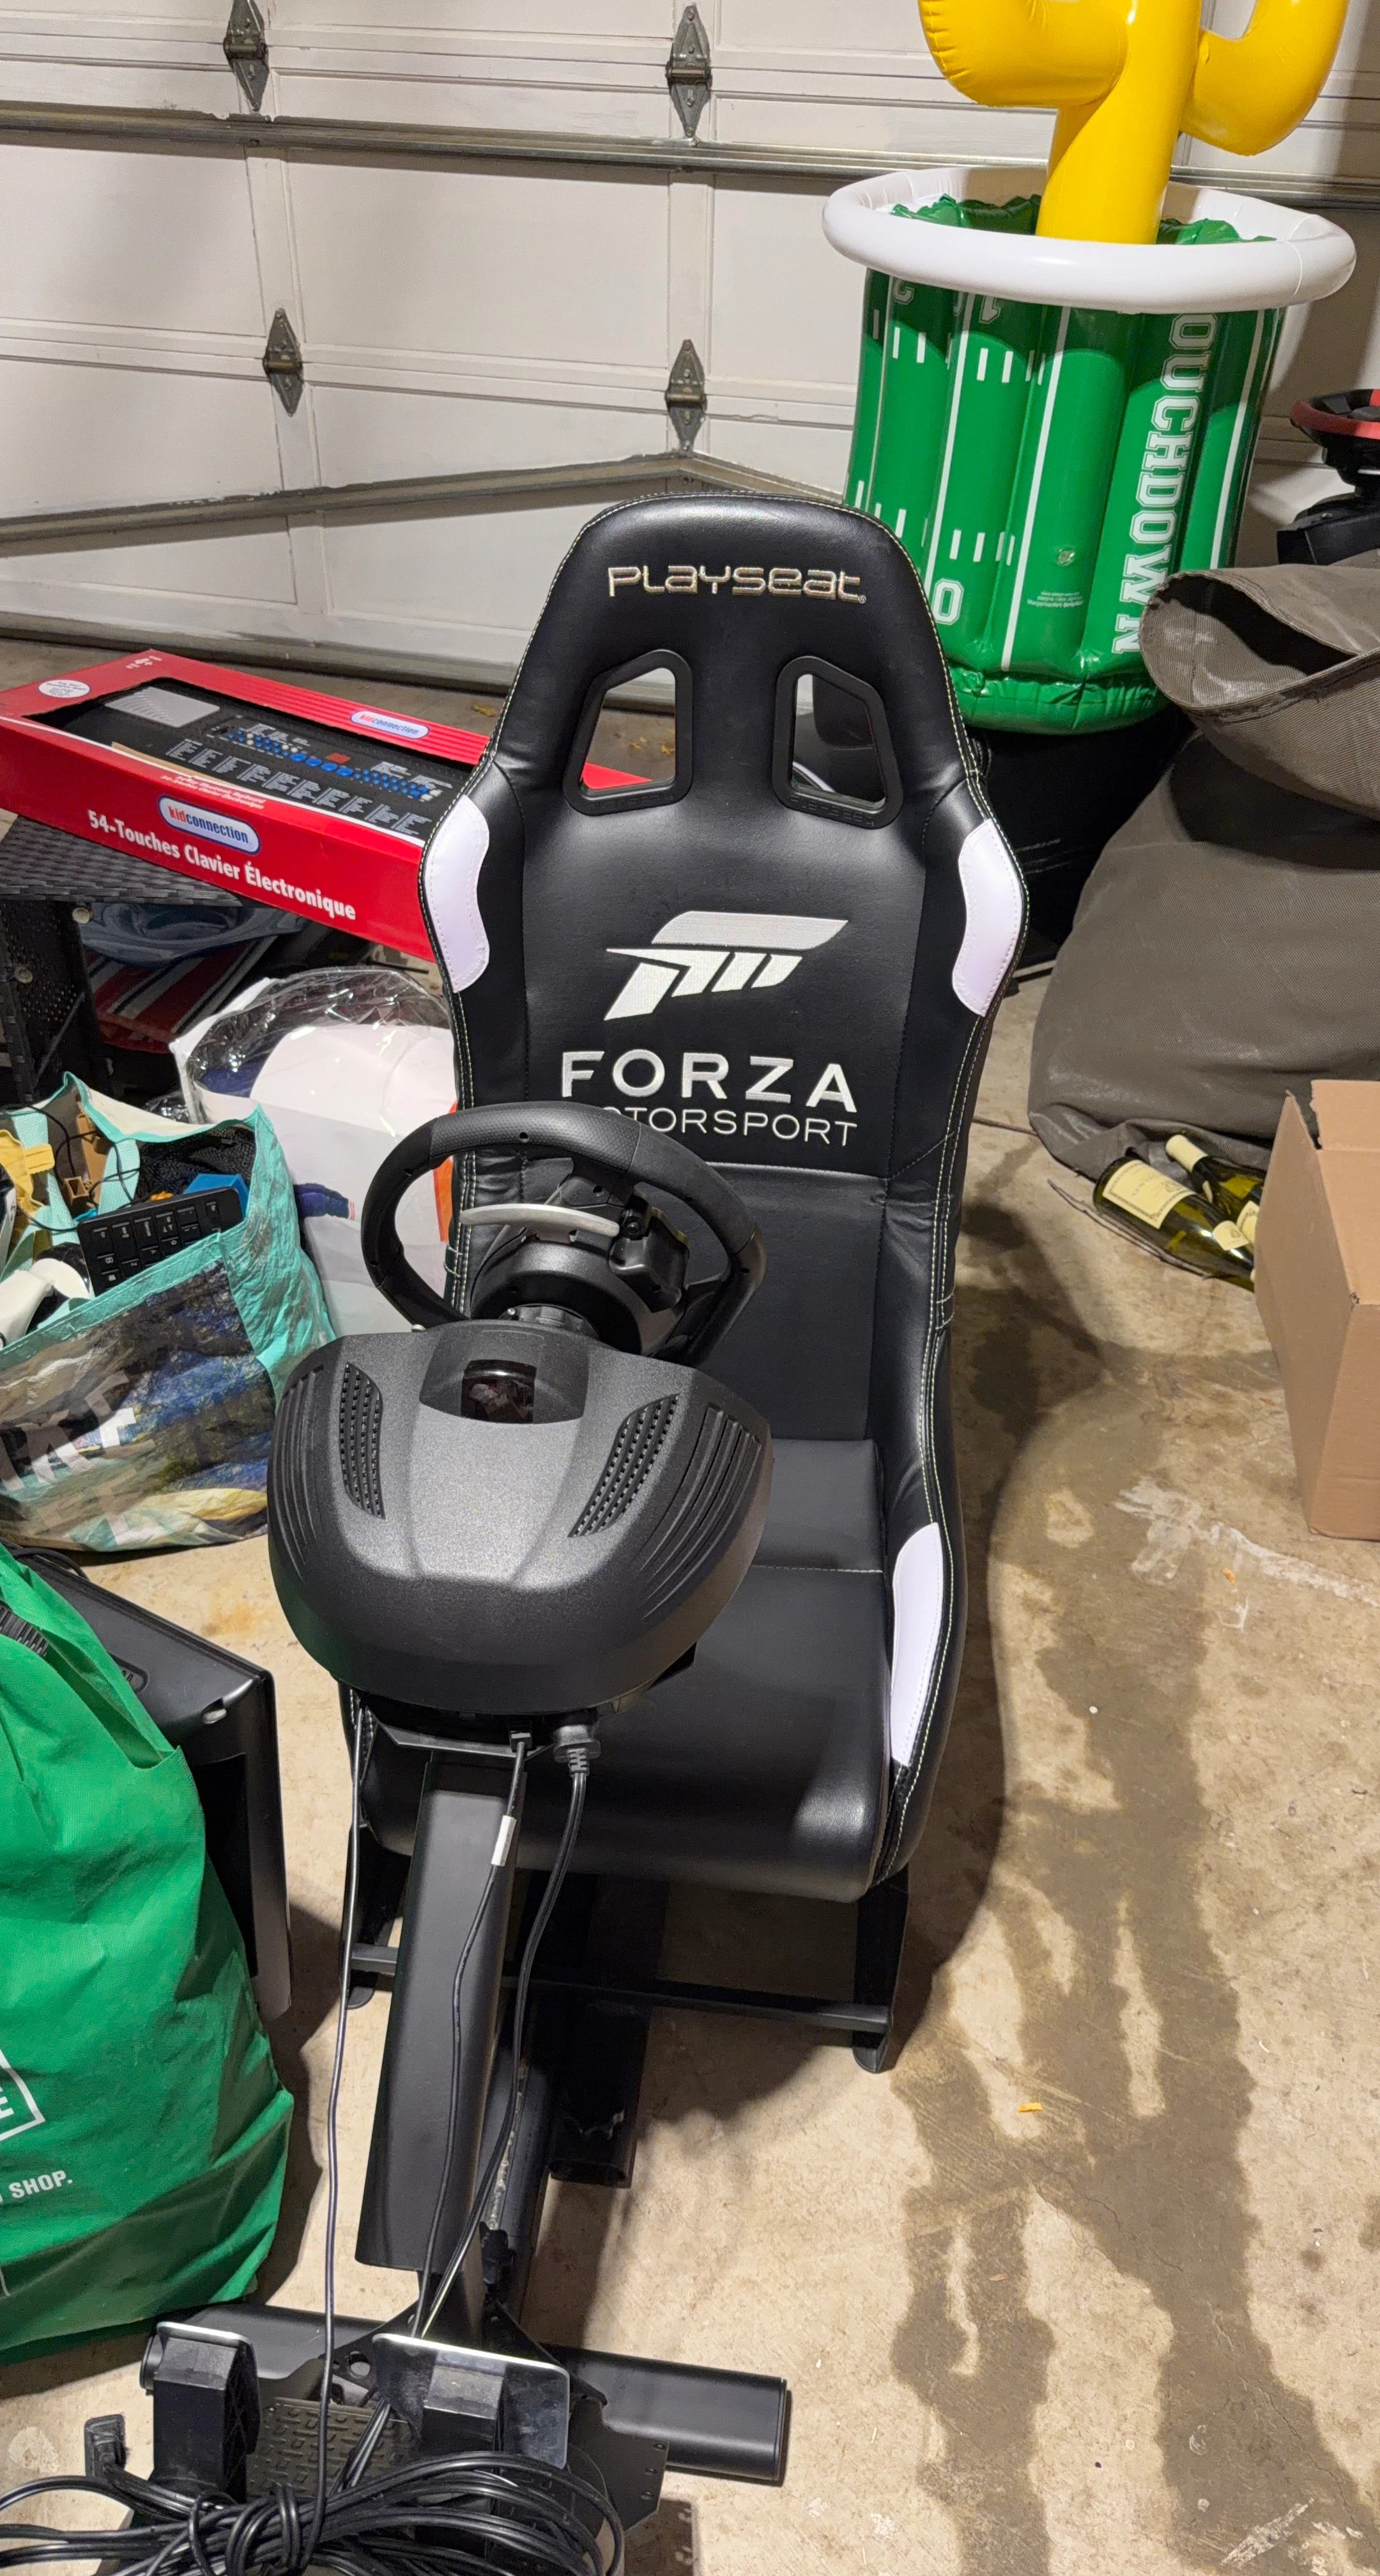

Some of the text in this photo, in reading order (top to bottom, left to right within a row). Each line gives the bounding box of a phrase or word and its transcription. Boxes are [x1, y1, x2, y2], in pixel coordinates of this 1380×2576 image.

[1112, 313, 1218, 654] OUCHDOWN
[931, 578, 965, 626] 0
[358, 714, 420, 735] kidconnection
[167, 806, 250, 844] kidconnection
[88, 809, 356, 921] 54-Touches Clavier Électronique
[562, 1048, 857, 1113] FORZA
[603, 1106, 857, 1147] TORSPORT
[9, 2170, 73, 2199] SHOP.
